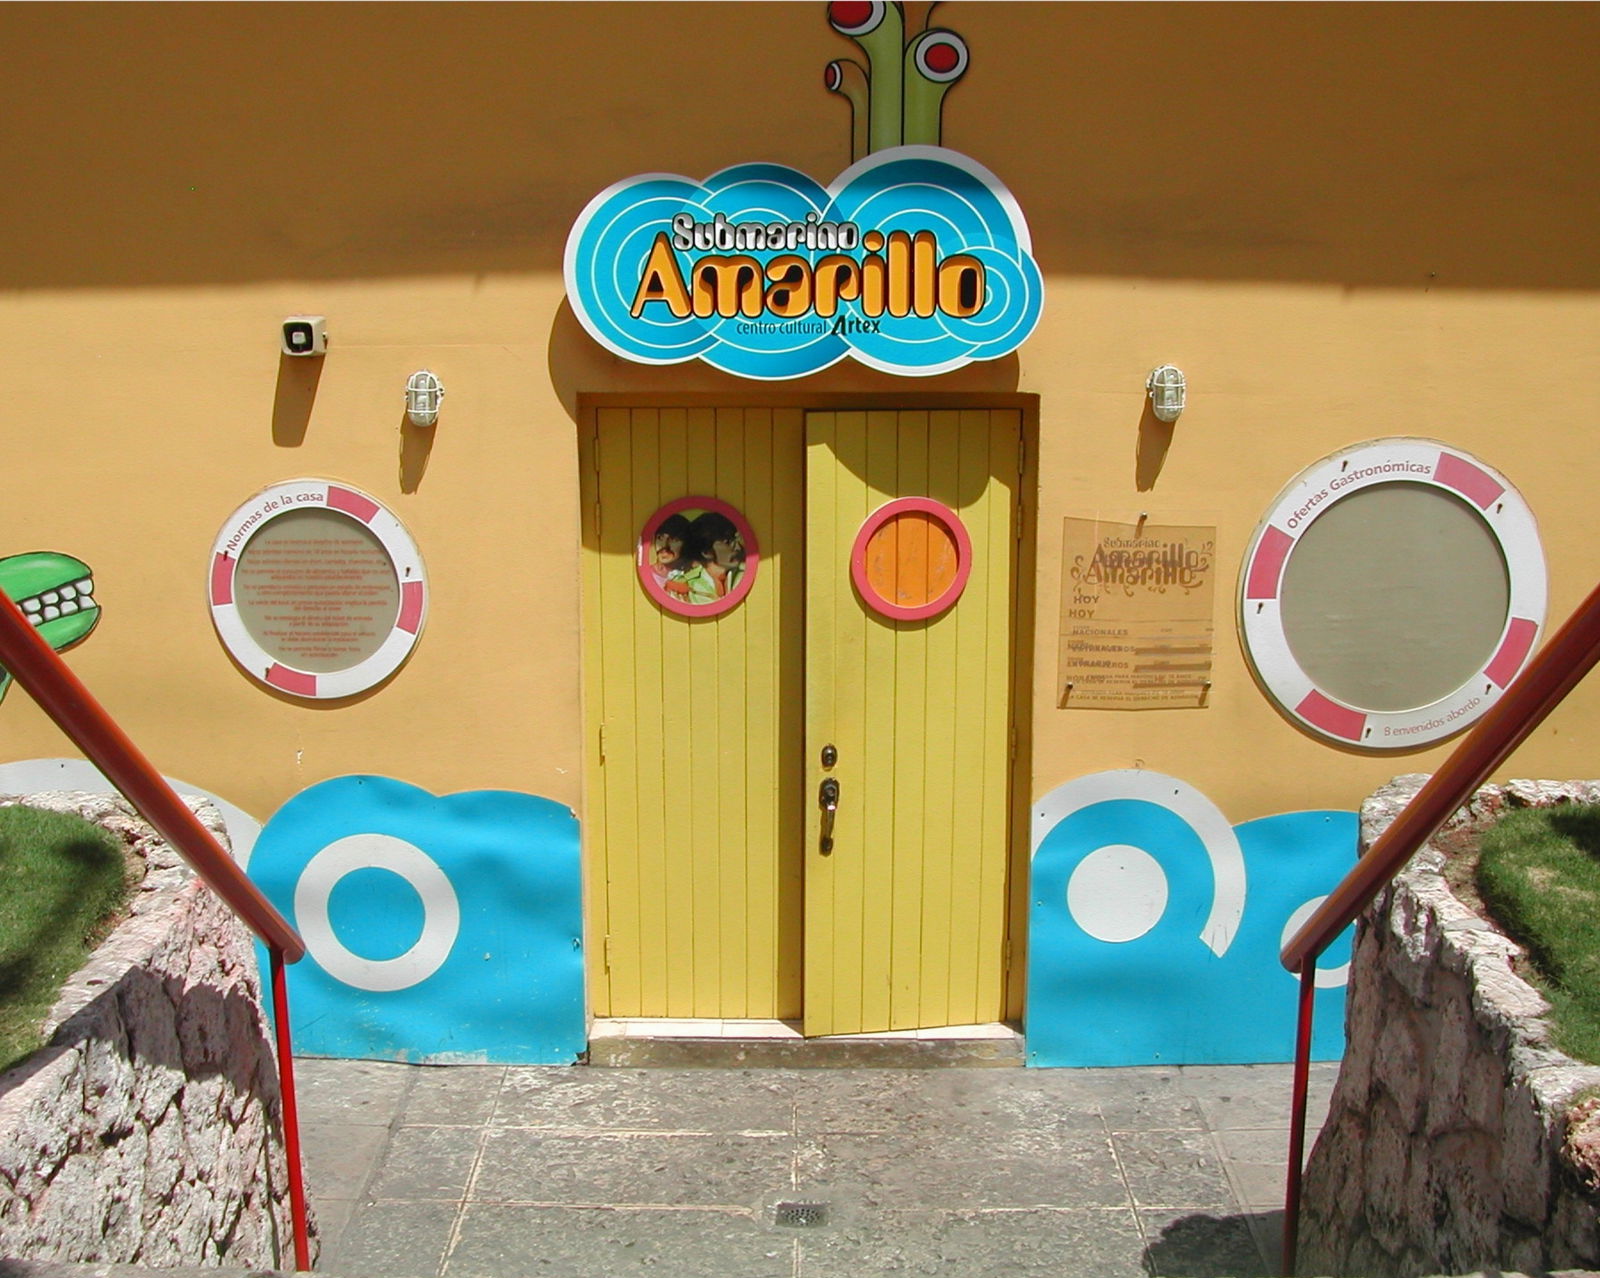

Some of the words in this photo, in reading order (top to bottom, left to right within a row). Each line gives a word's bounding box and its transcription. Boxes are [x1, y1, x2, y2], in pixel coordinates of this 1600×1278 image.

[671, 211, 860, 252] Submarino
[630, 230, 986, 319] Amarillo
[736, 321, 776, 335] centro
[778, 320, 827, 334] cultural
[830, 314, 881, 335] Artex
[1286, 488, 1329, 529] Ofertas
[1329, 459, 1432, 491] Gastronómicas
[226, 510, 263, 551] Normas
[263, 501, 279, 513] de
[280, 495, 293, 505] la
[296, 492, 324, 502] casa
[1068, 608, 1095, 619] HOY
[1073, 595, 1100, 605] HOY
